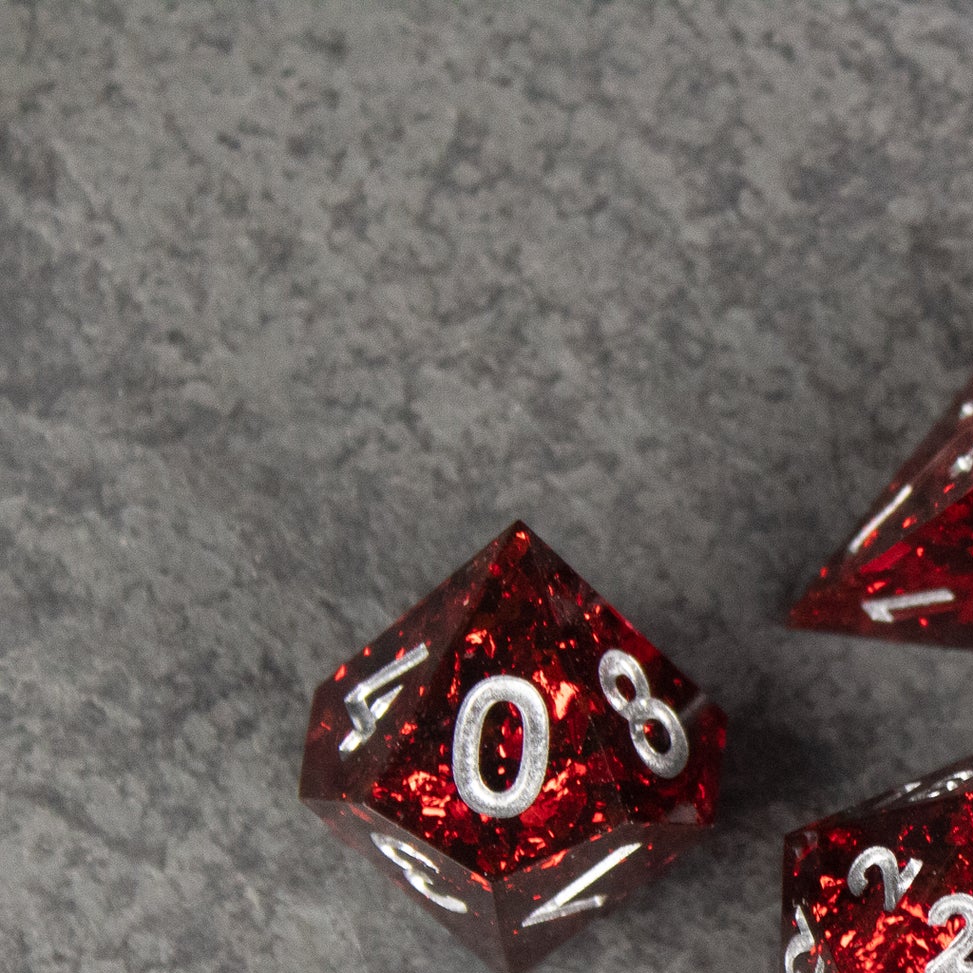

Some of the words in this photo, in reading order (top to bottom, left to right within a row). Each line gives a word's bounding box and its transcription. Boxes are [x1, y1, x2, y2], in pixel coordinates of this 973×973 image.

[861, 587, 955, 624] 1
[338, 641, 430, 762] 4
[451, 674, 551, 820] 0
[598, 648, 690, 780] 8
[370, 831, 469, 915] 3
[846, 845, 924, 913] 2
